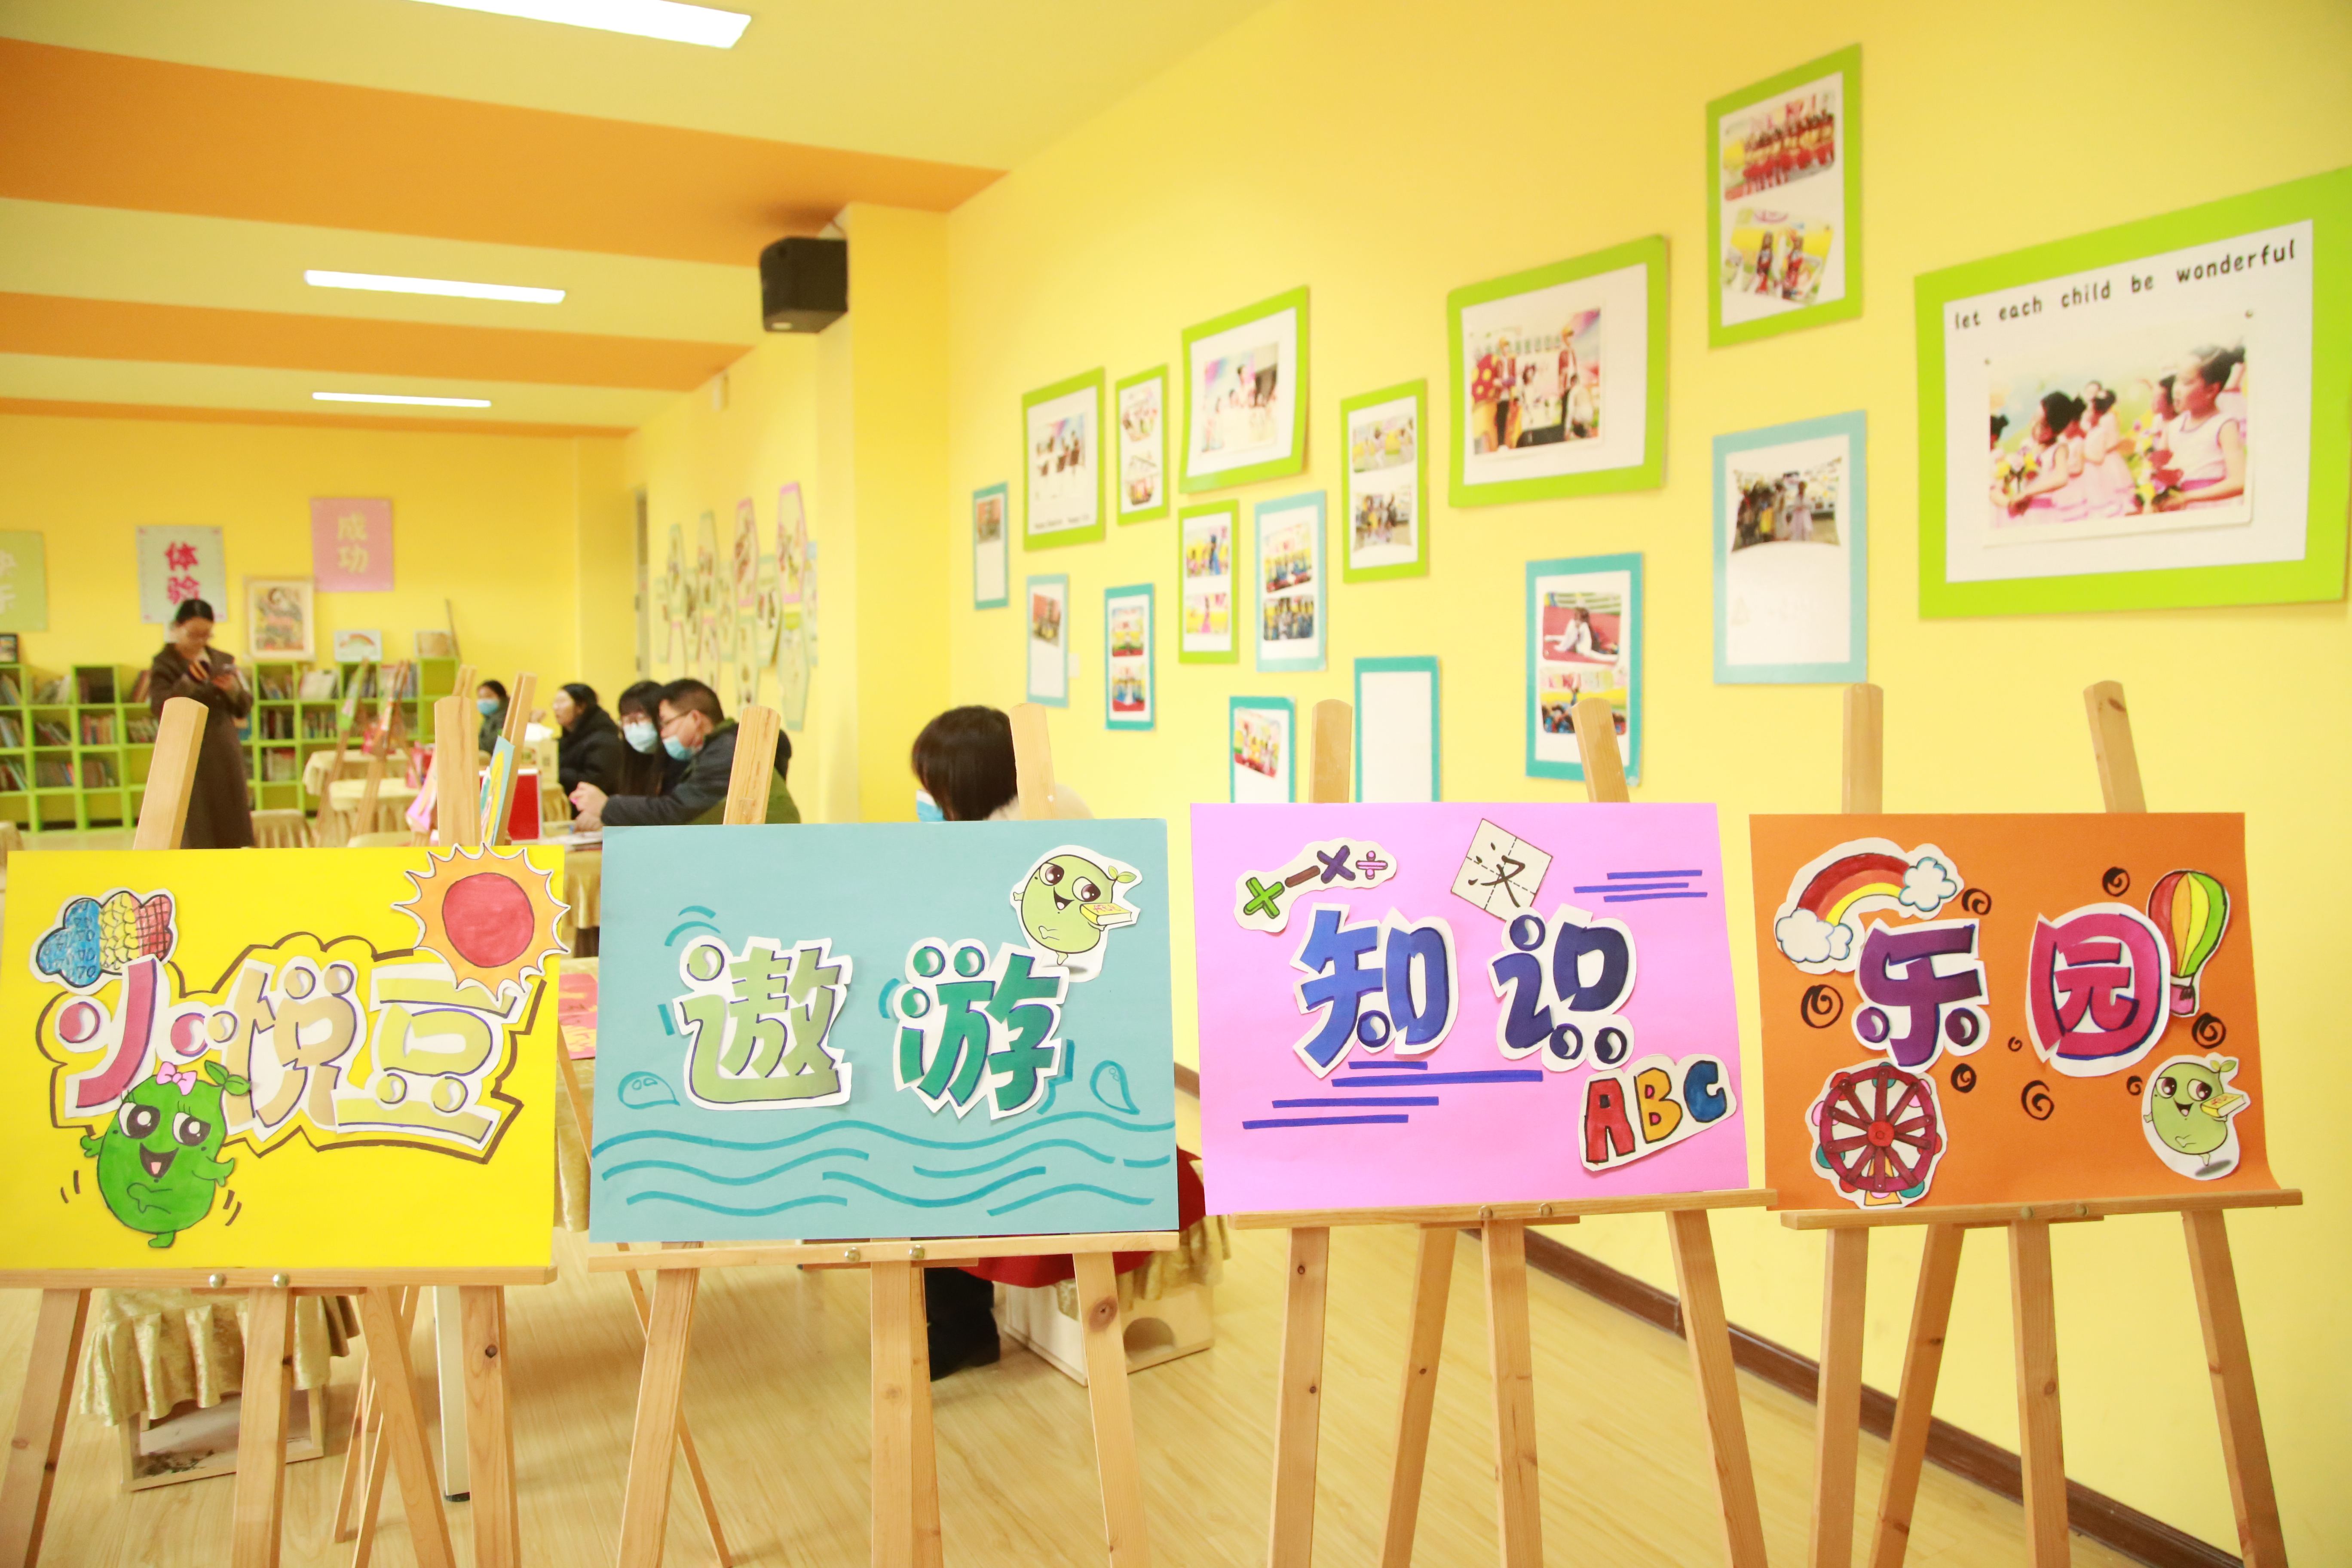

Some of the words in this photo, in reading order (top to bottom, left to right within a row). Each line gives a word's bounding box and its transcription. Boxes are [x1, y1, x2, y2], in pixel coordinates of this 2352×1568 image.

[1955, 313, 1980, 330] let
[1999, 297, 2043, 321] each
[2061, 281, 2110, 309] child
[2132, 276, 2153, 293] be
[2177, 239, 2296, 284] wonderful
[337, 511, 370, 574] 成功
[1468, 842, 1526, 908] 汉
[682, 945, 1062, 1112] 遨游
[1301, 910, 1630, 1068] 知识
[1856, 913, 2162, 1067] 乐园
[1585, 1060, 1726, 1163] ABC
